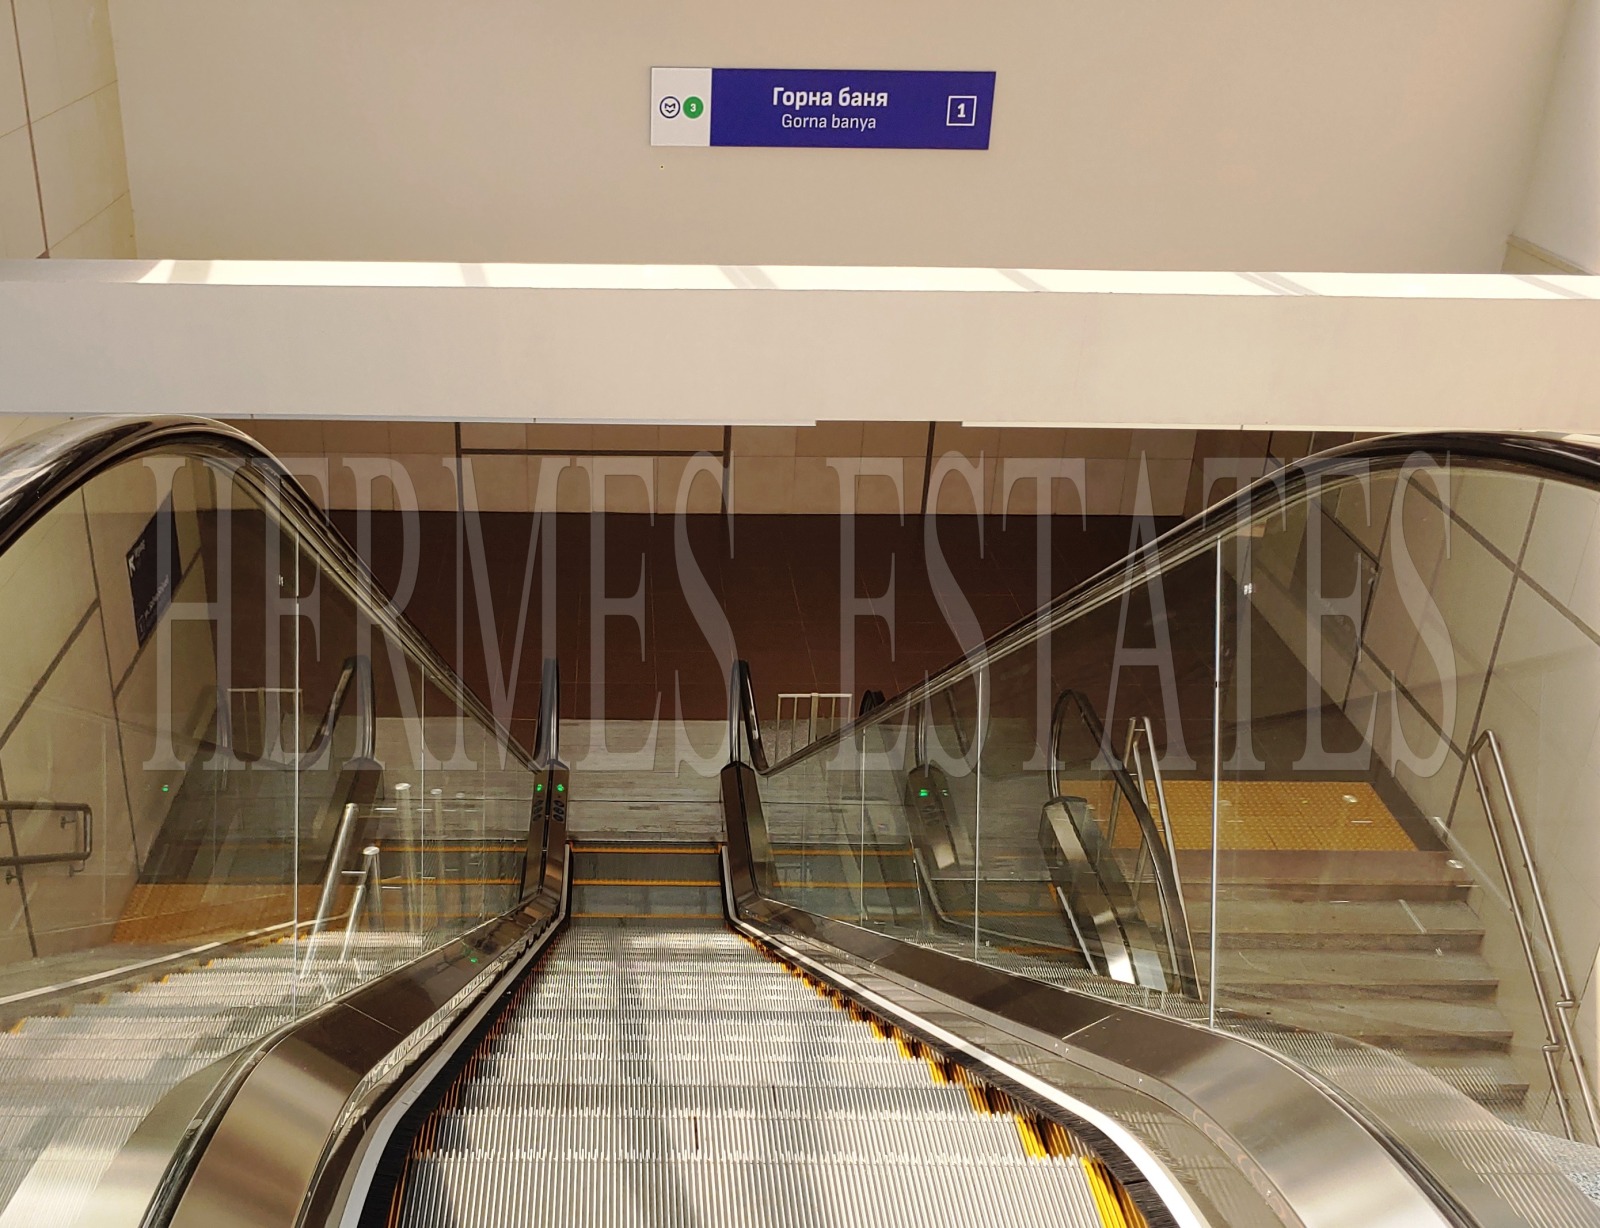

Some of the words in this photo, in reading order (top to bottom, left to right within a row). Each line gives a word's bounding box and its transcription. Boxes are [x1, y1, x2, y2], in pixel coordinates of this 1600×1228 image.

[773, 86, 833, 110] Горна
[838, 86, 888, 107] баня
[689, 103, 697, 112] 3
[957, 103, 966, 118] 1
[781, 114, 827, 129] Gorna
[832, 114, 876, 132] banya
